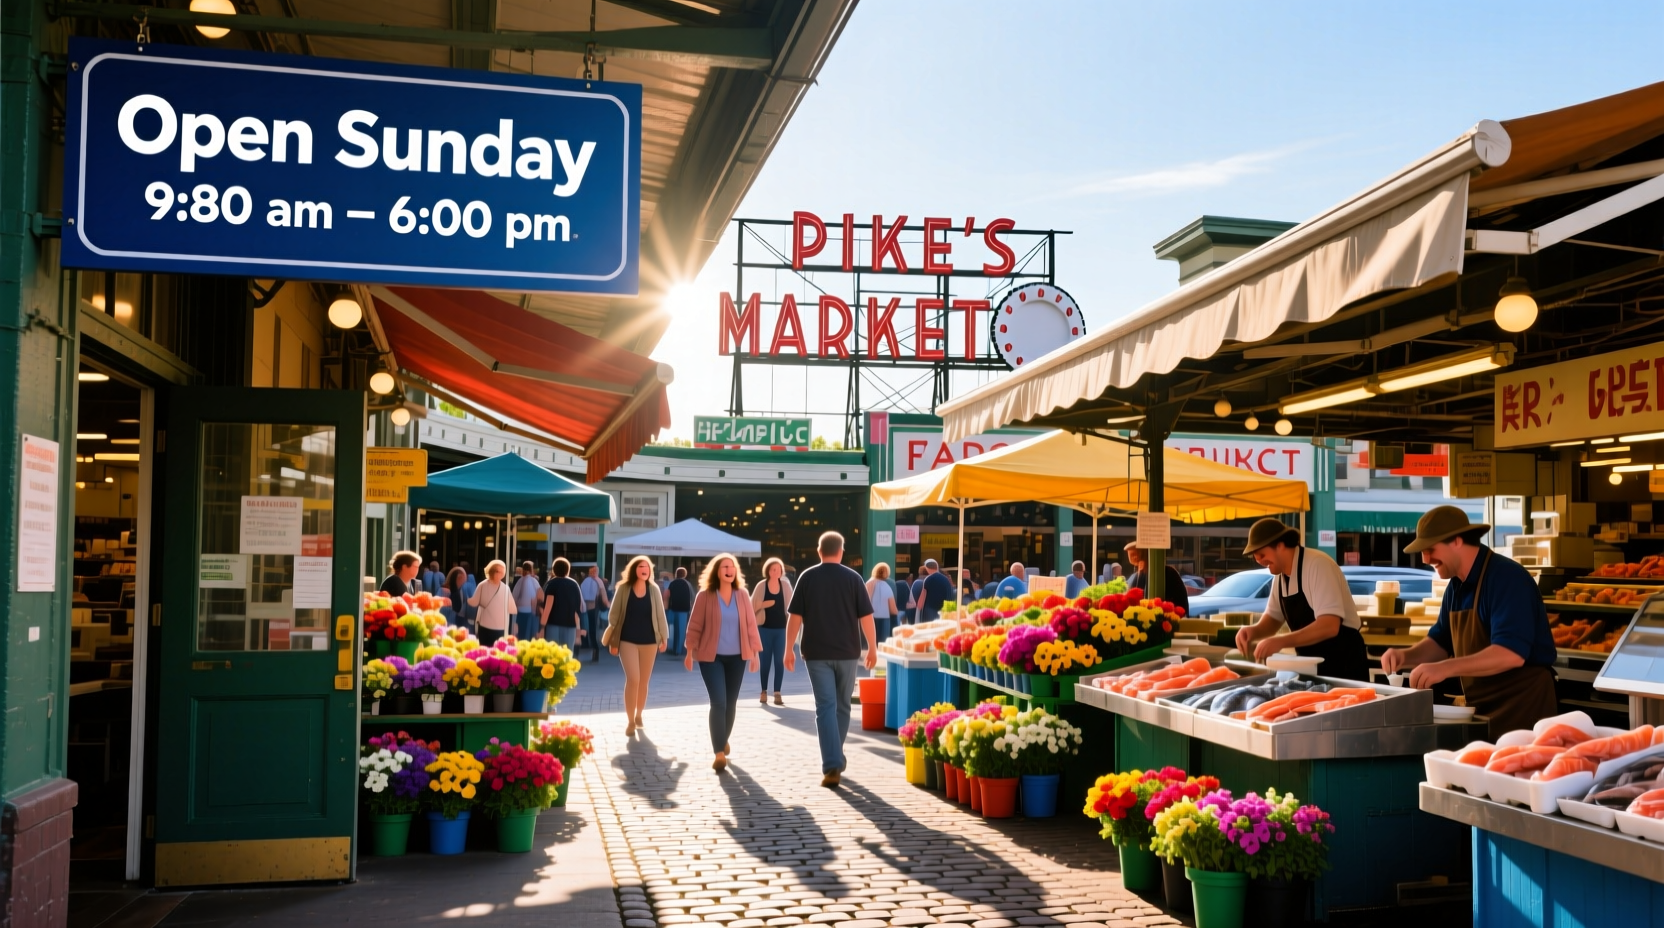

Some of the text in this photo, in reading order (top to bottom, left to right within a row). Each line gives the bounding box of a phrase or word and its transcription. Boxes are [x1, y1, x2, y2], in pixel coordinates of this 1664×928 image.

[117, 94, 597, 198] Open Sunday
[144, 181, 253, 225] 9:80
[266, 198, 333, 230] am
[388, 195, 493, 239] 6:00
[718, 291, 991, 361] MARKET
